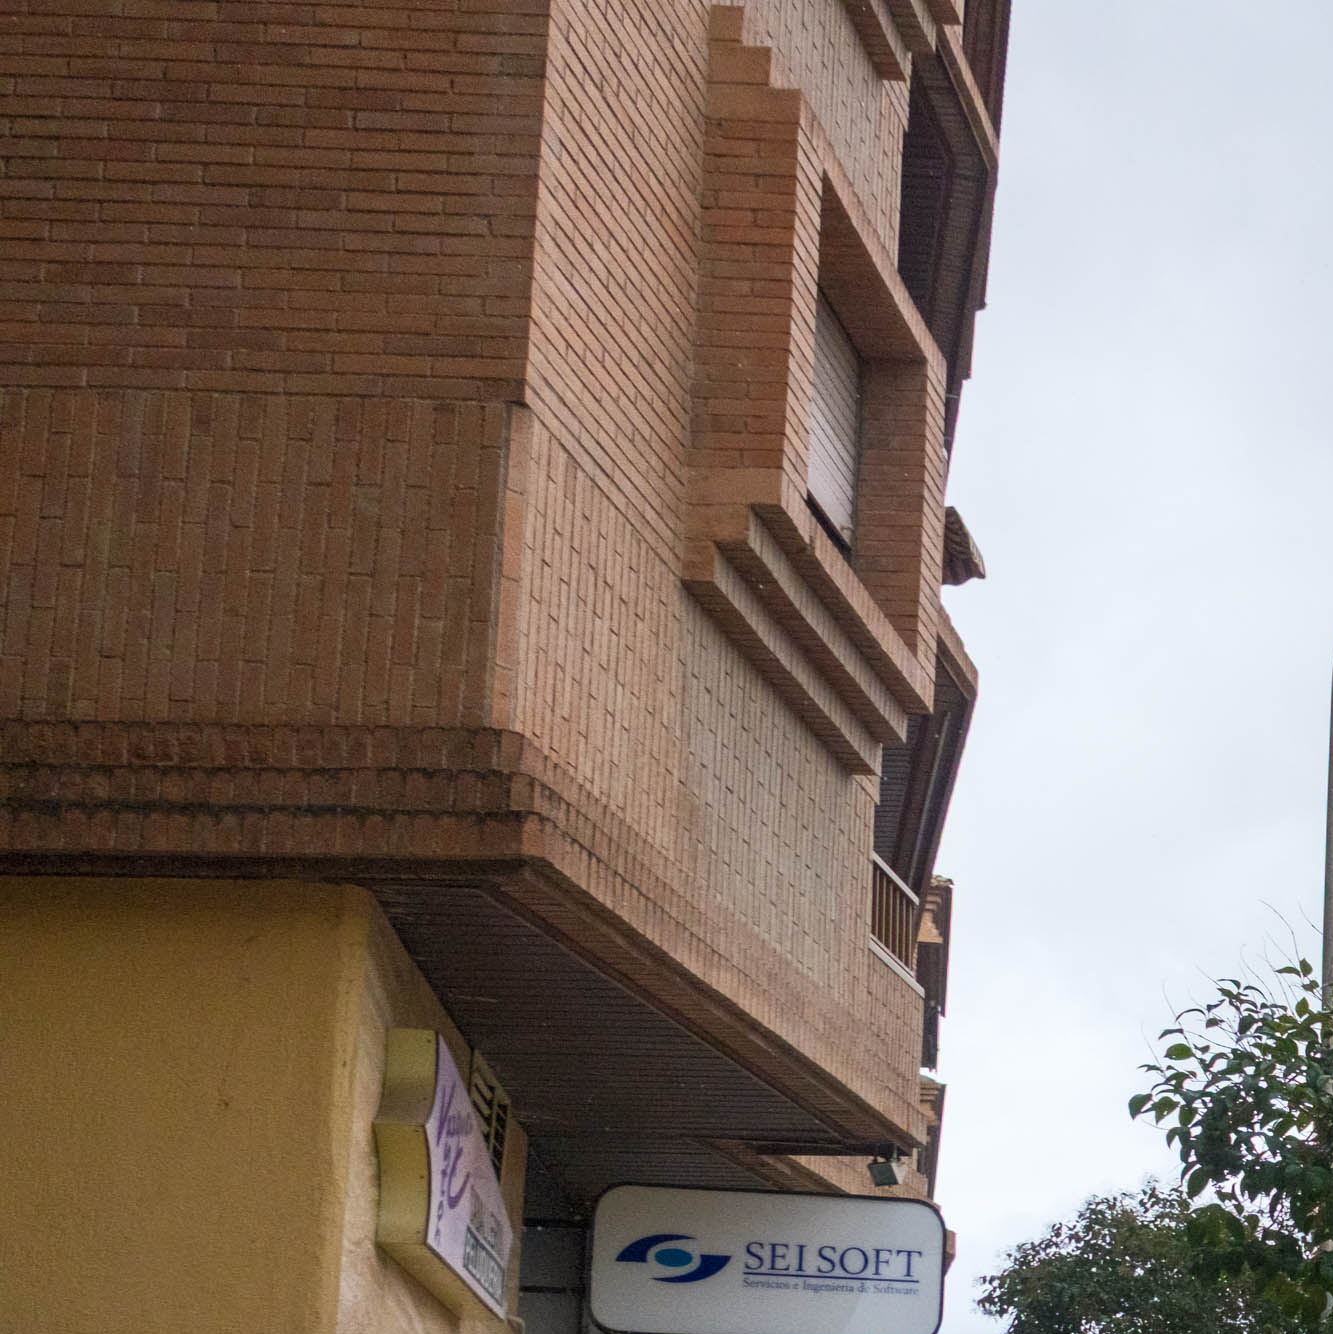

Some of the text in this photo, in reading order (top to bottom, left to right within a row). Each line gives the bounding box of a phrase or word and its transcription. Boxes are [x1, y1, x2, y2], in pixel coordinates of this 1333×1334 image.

[744, 1241, 923, 1277] SEI SOFT
[743, 1278, 791, 1290] Servicios
[857, 1281, 871, 1293] de
[873, 1283, 920, 1296] Software
